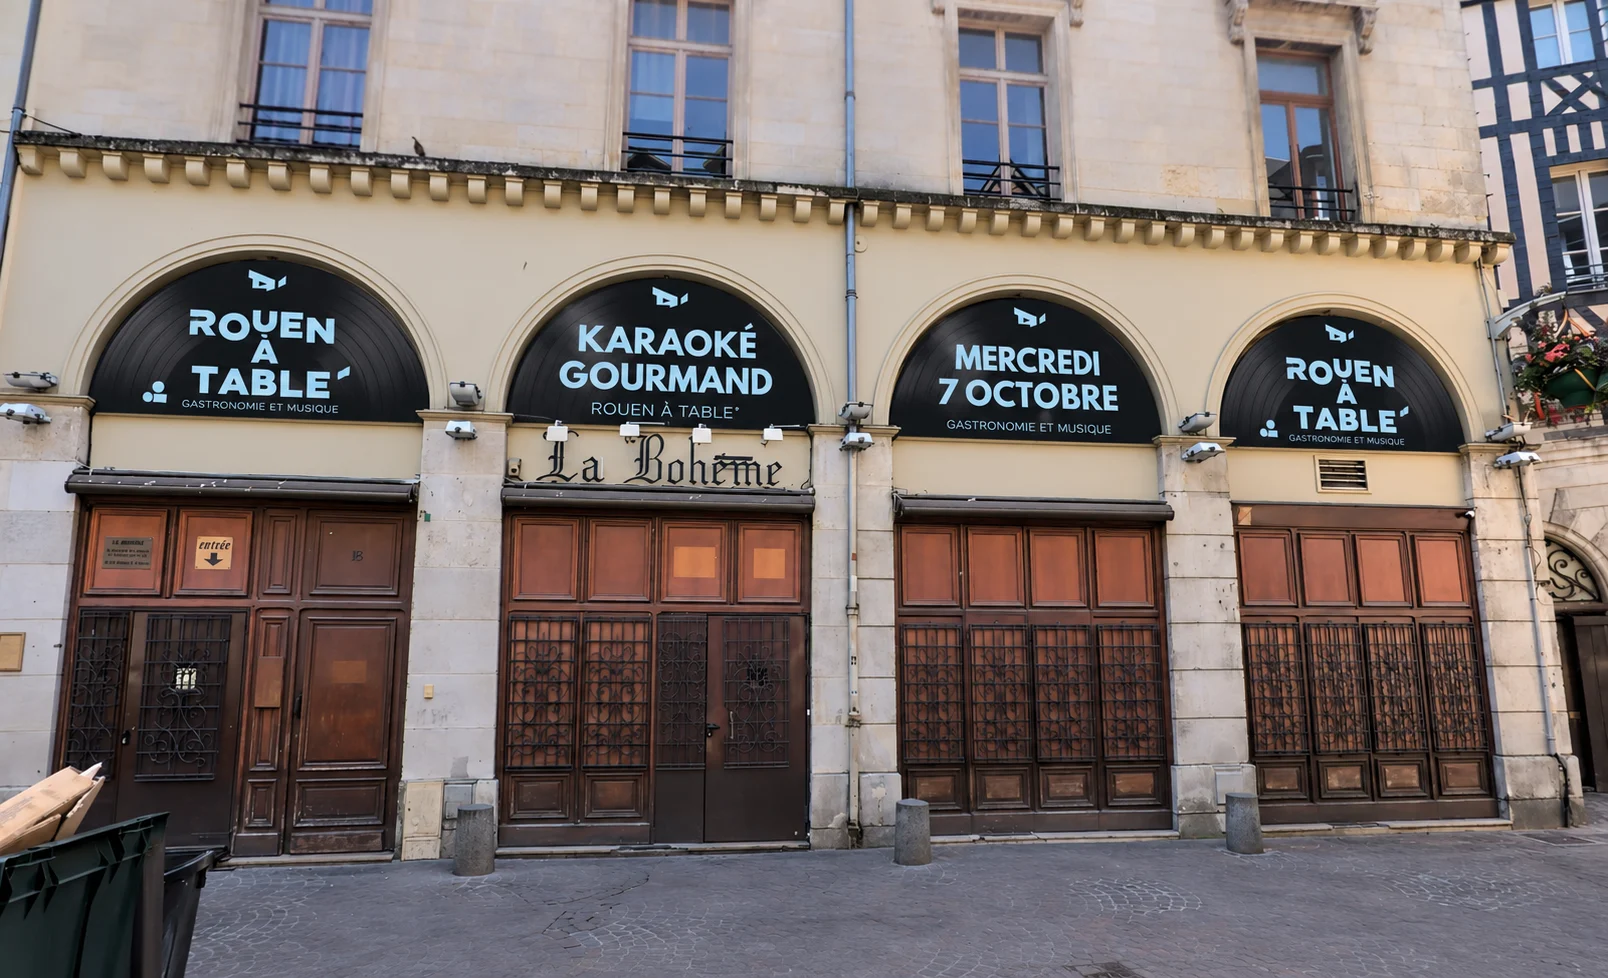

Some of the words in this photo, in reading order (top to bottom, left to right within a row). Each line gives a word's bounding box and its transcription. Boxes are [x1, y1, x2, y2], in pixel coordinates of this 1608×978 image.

[189, 308, 335, 345] ROUEN
[577, 322, 757, 359] KARAOKÉ
[250, 333, 279, 365] À
[955, 344, 1101, 377] MERCREDI
[559, 360, 773, 396] GOURMAND
[1285, 356, 1395, 388] ROUEN
[181, 399, 266, 412] GASTRONOMIE
[269, 402, 284, 413] ET
[286, 403, 340, 415] MUSIQUE
[938, 378, 960, 405] 7
[965, 379, 1119, 412] OCTOBRE
[1336, 378, 1358, 405] À
[591, 402, 654, 417] ROUEN
[660, 400, 673, 418] À
[946, 419, 1036, 432] GASTRONOMIE
[1039, 422, 1054, 433] ET
[1057, 423, 1112, 436] MUSIQUE
[1288, 434, 1352, 445] GASTRONOMIE
[1354, 436, 1365, 445] ET
[1367, 437, 1406, 446] MUSIQUE
[536, 429, 604, 484] La
[198, 539, 231, 551] entrée
